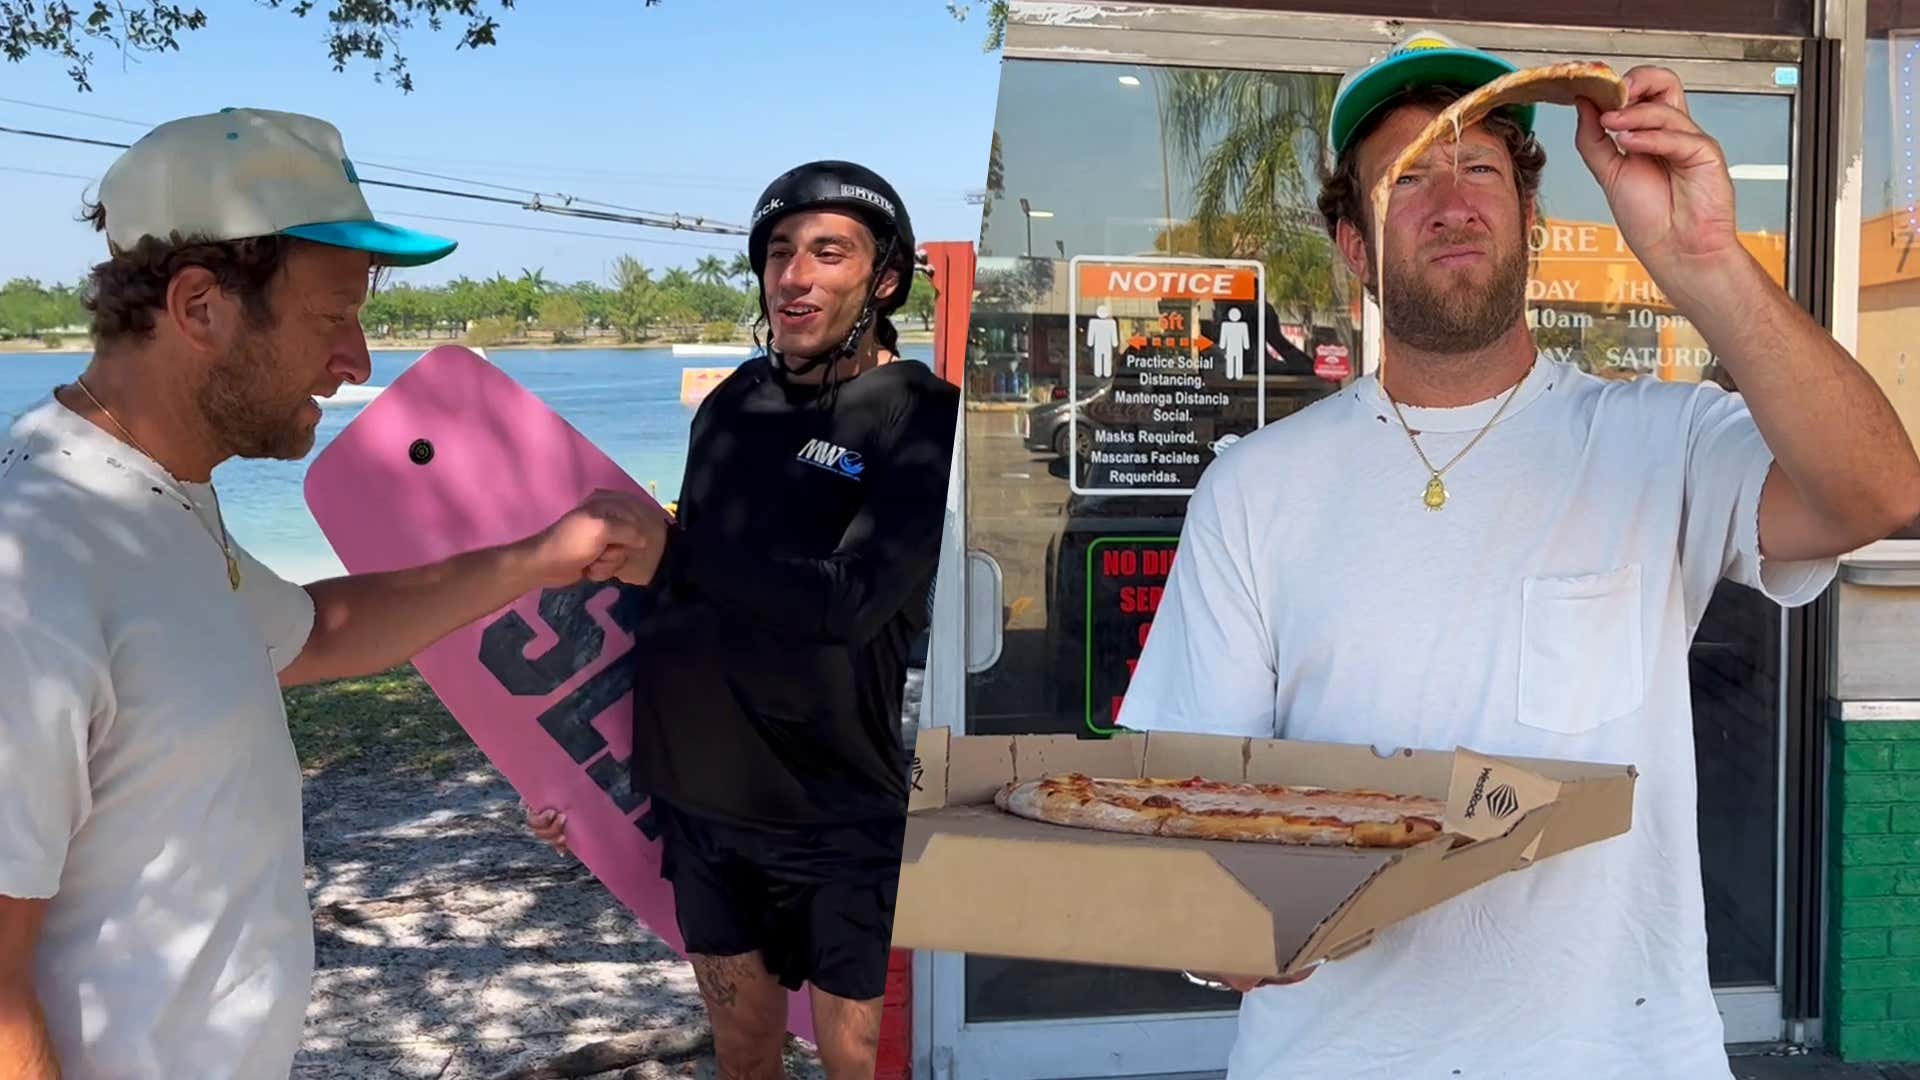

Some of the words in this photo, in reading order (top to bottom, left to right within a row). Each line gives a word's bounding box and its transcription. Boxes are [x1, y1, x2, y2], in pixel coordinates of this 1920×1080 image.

[1108, 270, 1235, 295] NOTICE
[1159, 311, 1185, 332] 6ft
[1534, 308, 1593, 329] 10am
[1126, 354, 1175, 370] Practice
[1177, 354, 1214, 370] Social
[1139, 372, 1206, 389] Distancing.
[1115, 390, 1173, 407] Mantenga
[1175, 391, 1230, 406] Distancia
[1153, 408, 1193, 422] Social.
[1095, 429, 1135, 444] Masks
[1138, 430, 1199, 446] Required.
[1091, 450, 1149, 464] Mascaras
[1151, 450, 1200, 465] Faciales
[1109, 469, 1181, 485] Requeridas.
[1103, 549, 1137, 577] NO
[1464, 767, 1493, 818] WestRock
